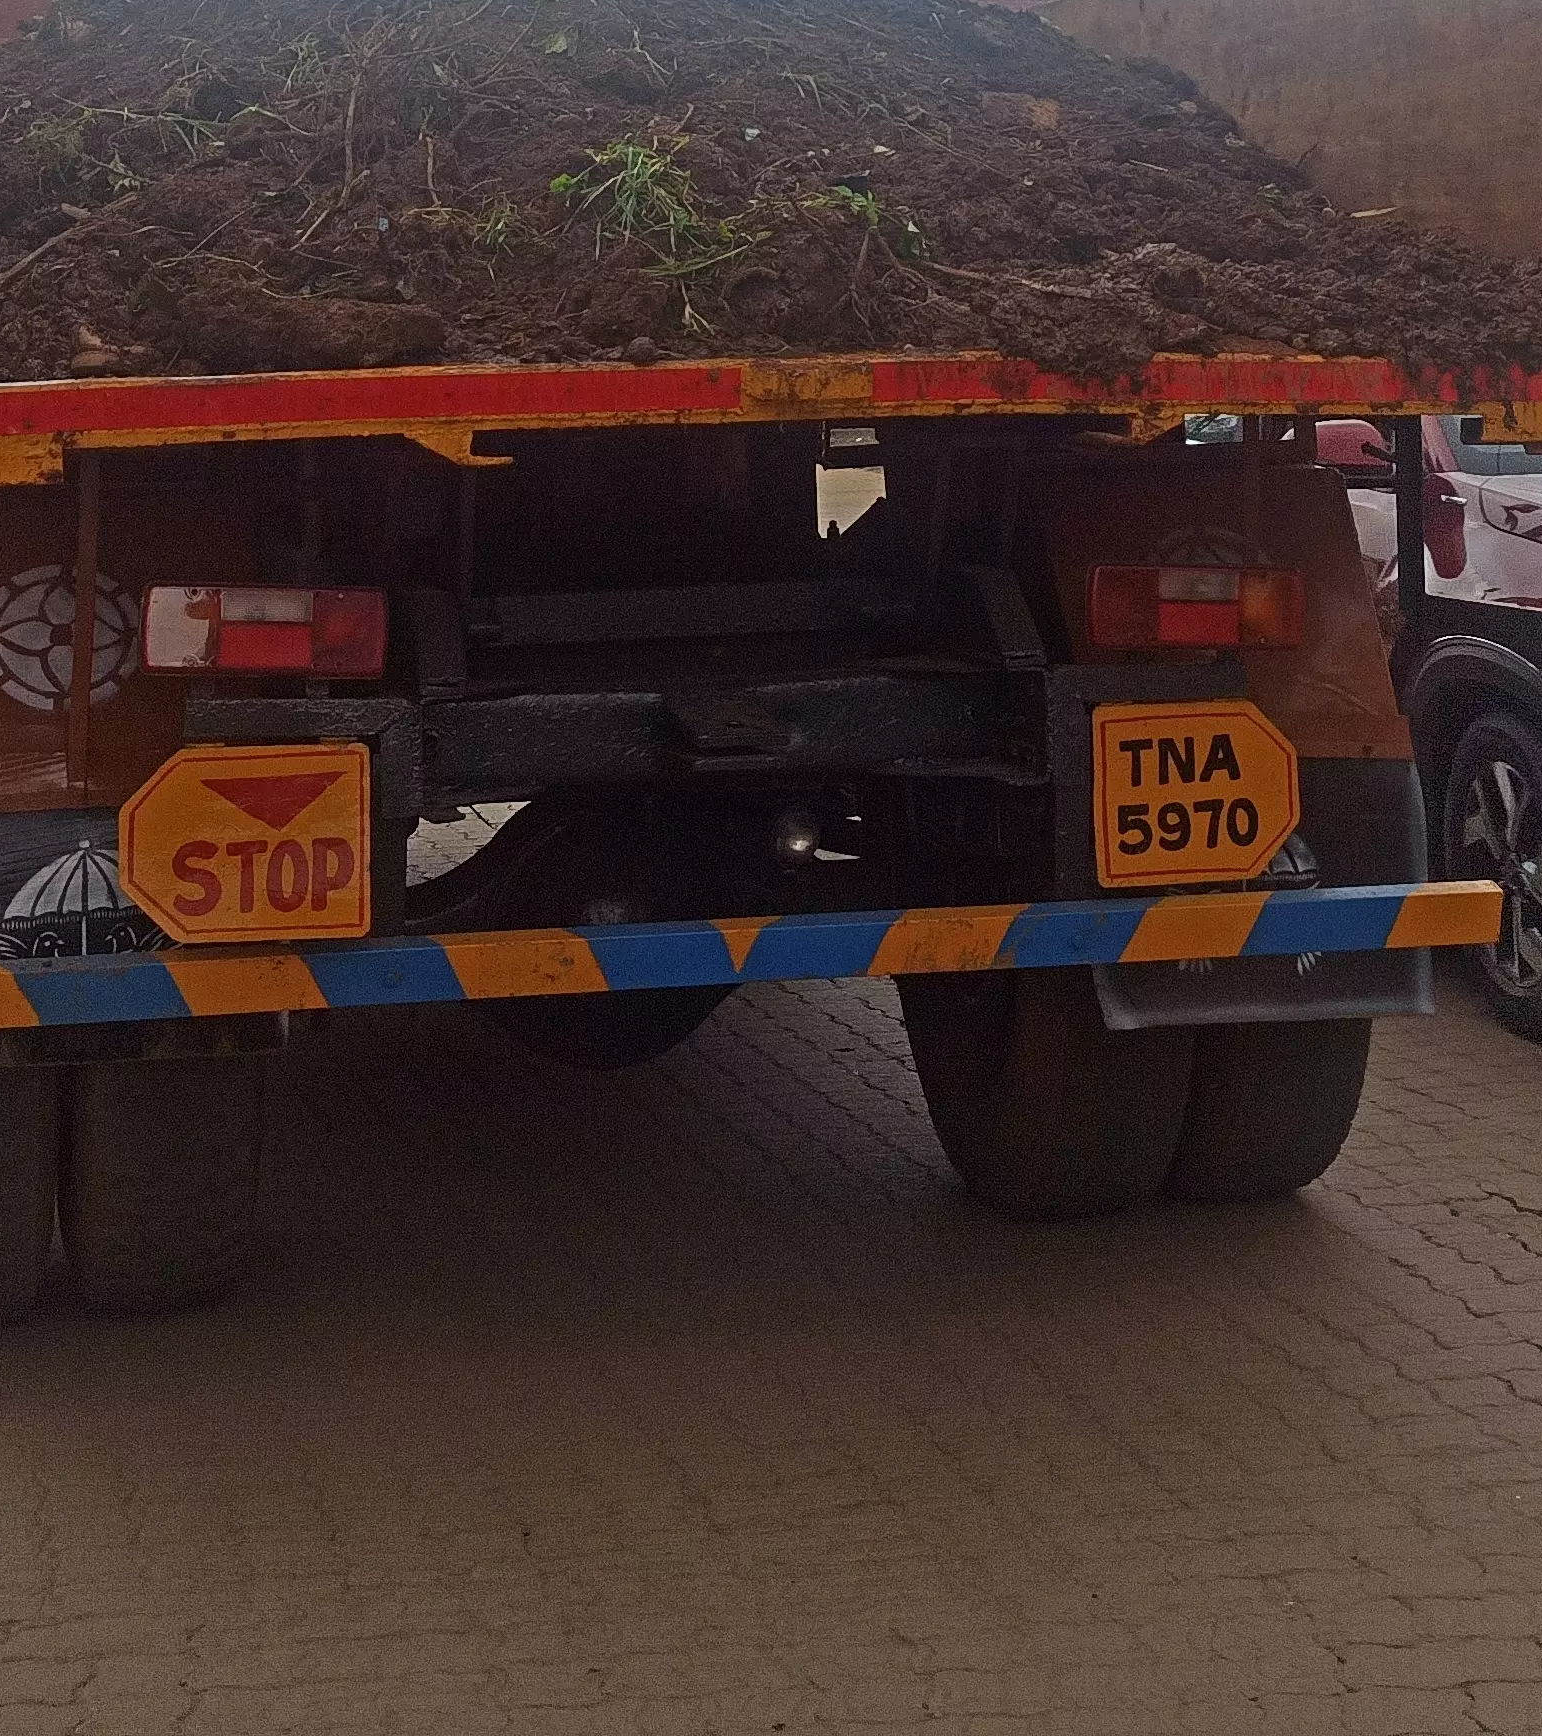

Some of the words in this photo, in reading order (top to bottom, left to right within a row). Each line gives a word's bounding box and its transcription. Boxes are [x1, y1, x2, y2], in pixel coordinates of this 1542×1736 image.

[1119, 733, 1241, 788] TNA
[1117, 797, 1259, 856] 5970
[170, 836, 354, 917] STOP
